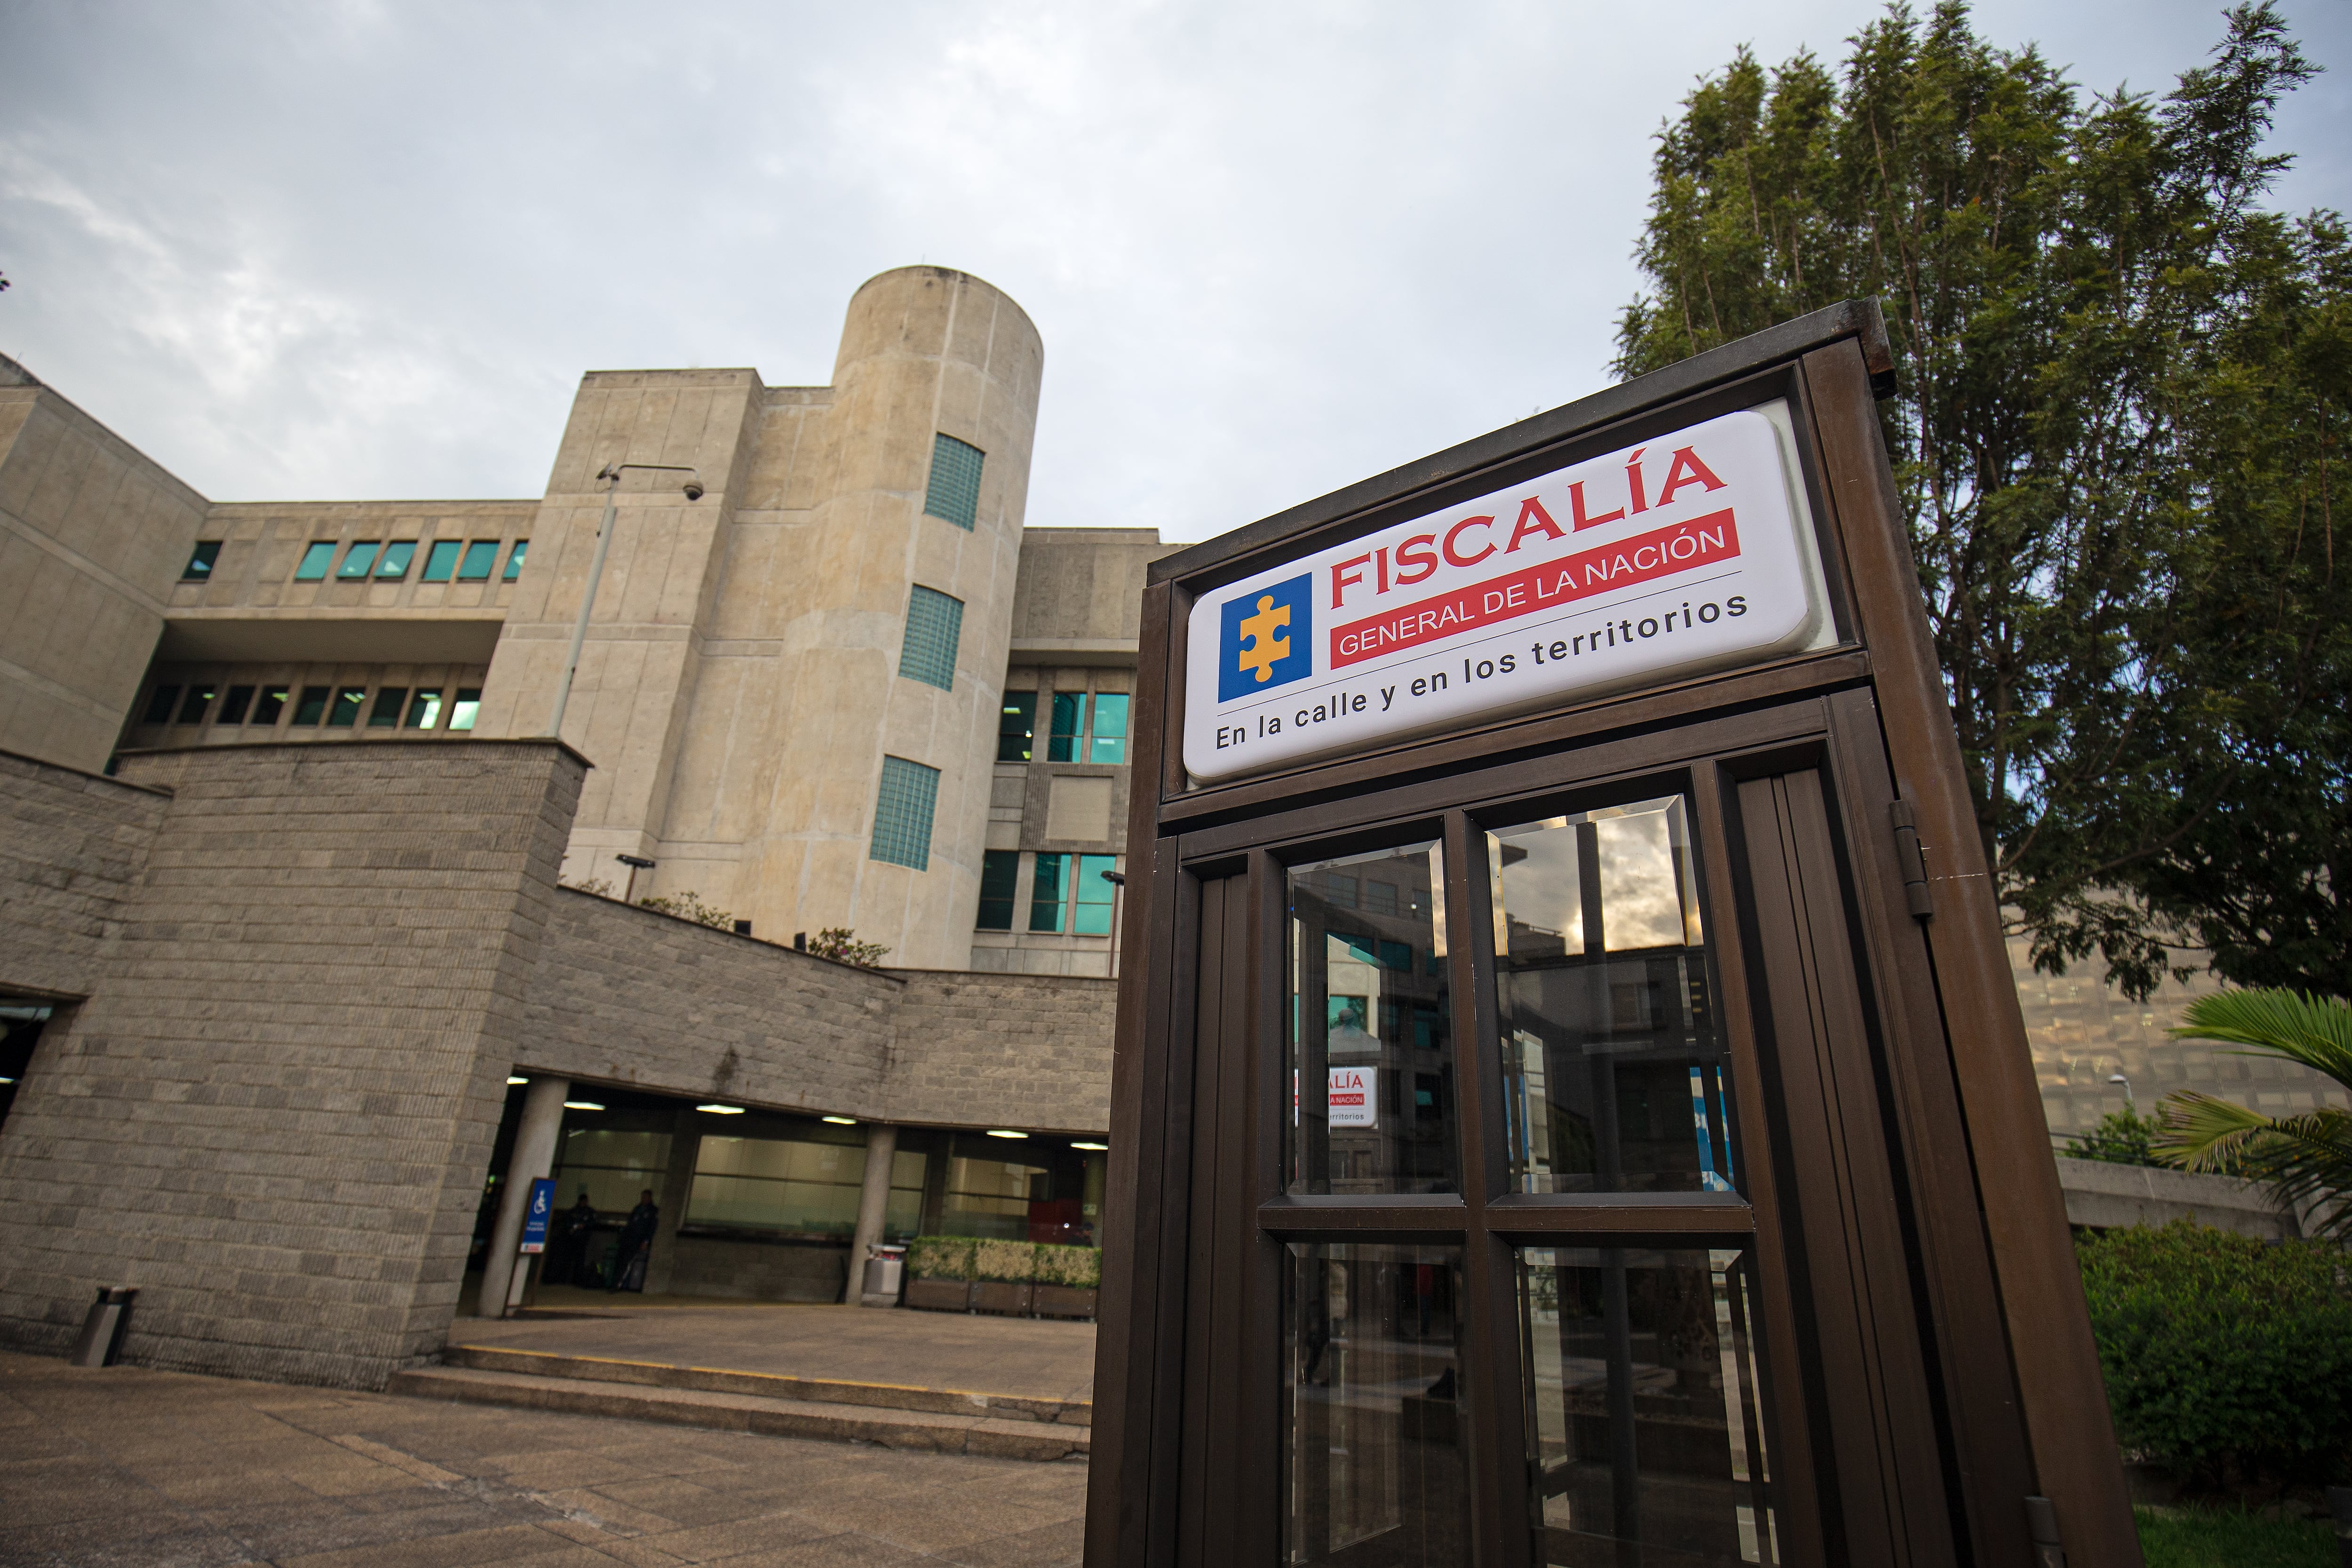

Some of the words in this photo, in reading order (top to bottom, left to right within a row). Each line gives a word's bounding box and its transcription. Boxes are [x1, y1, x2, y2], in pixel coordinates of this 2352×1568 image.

[1330, 447, 1728, 609] FISCALÍA
[1340, 601, 1476, 656] GENERAL
[1483, 583, 1526, 614] DE
[1536, 570, 1578, 600] LA
[1584, 525, 1726, 586] NACIÓN
[1216, 726, 1245, 750] En
[1259, 715, 1281, 738] la
[1295, 692, 1367, 727] calle
[1381, 685, 1396, 712] y
[1411, 673, 1447, 697] en
[1464, 654, 1516, 683] los
[1532, 596, 1747, 665] territorios
[1336, 1095, 1363, 1103] NACIÓN
